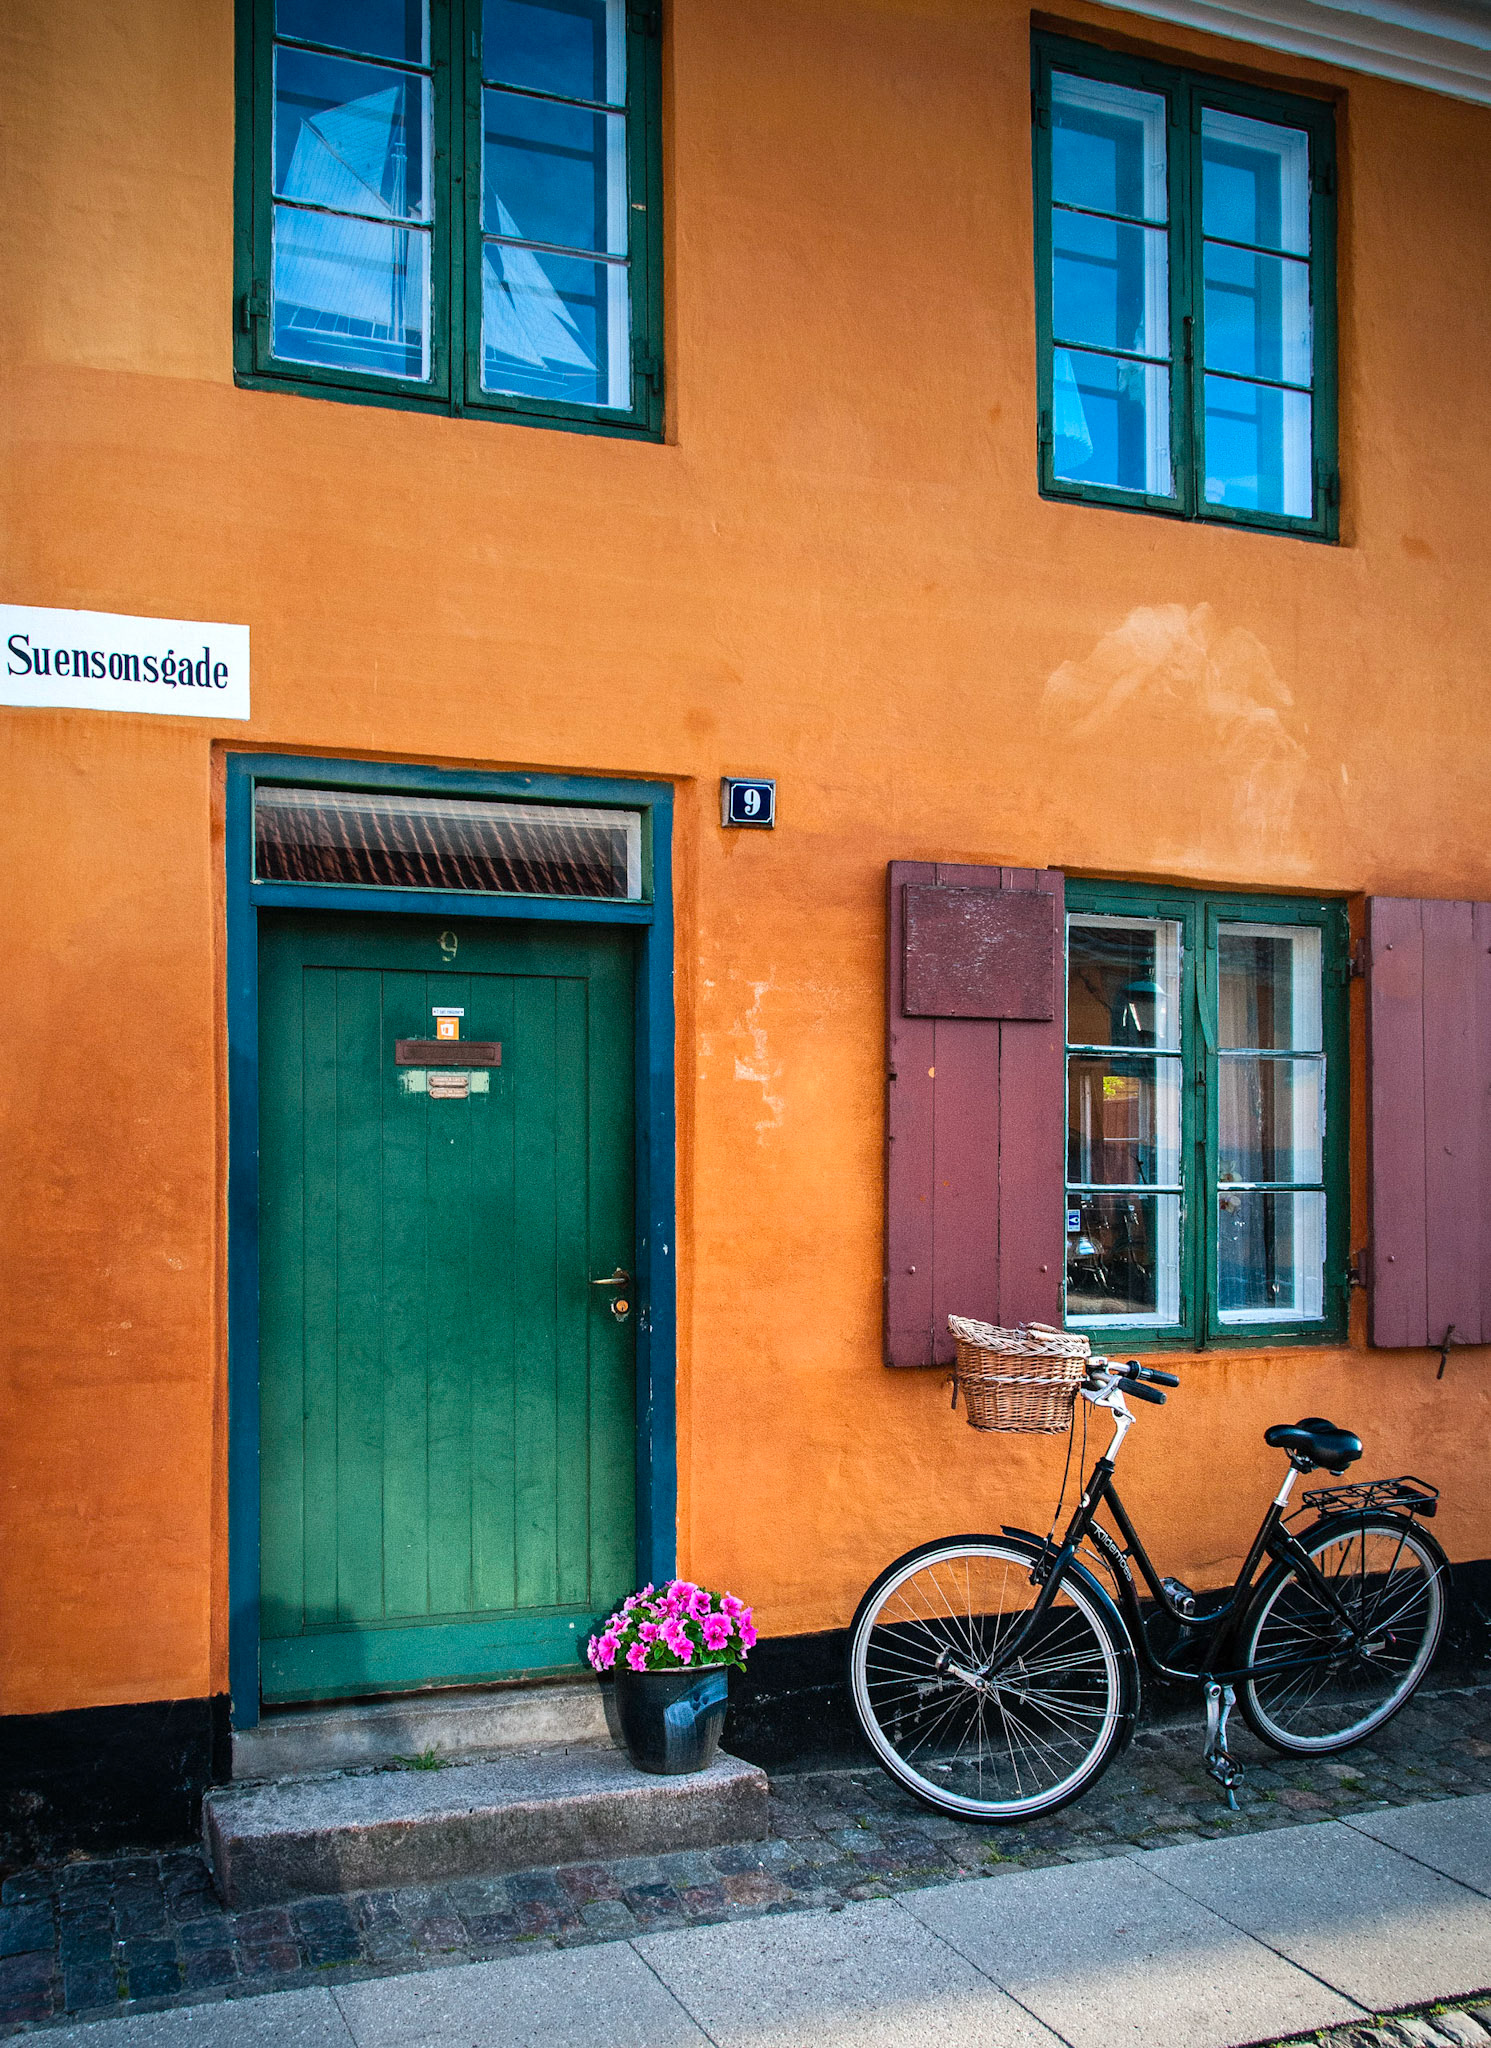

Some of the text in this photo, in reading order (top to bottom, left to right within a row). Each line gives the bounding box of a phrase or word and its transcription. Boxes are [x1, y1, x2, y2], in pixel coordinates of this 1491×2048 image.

[7, 633, 229, 689] Suensonsgade
[744, 788, 761, 816] 9
[440, 931, 458, 962] 9
